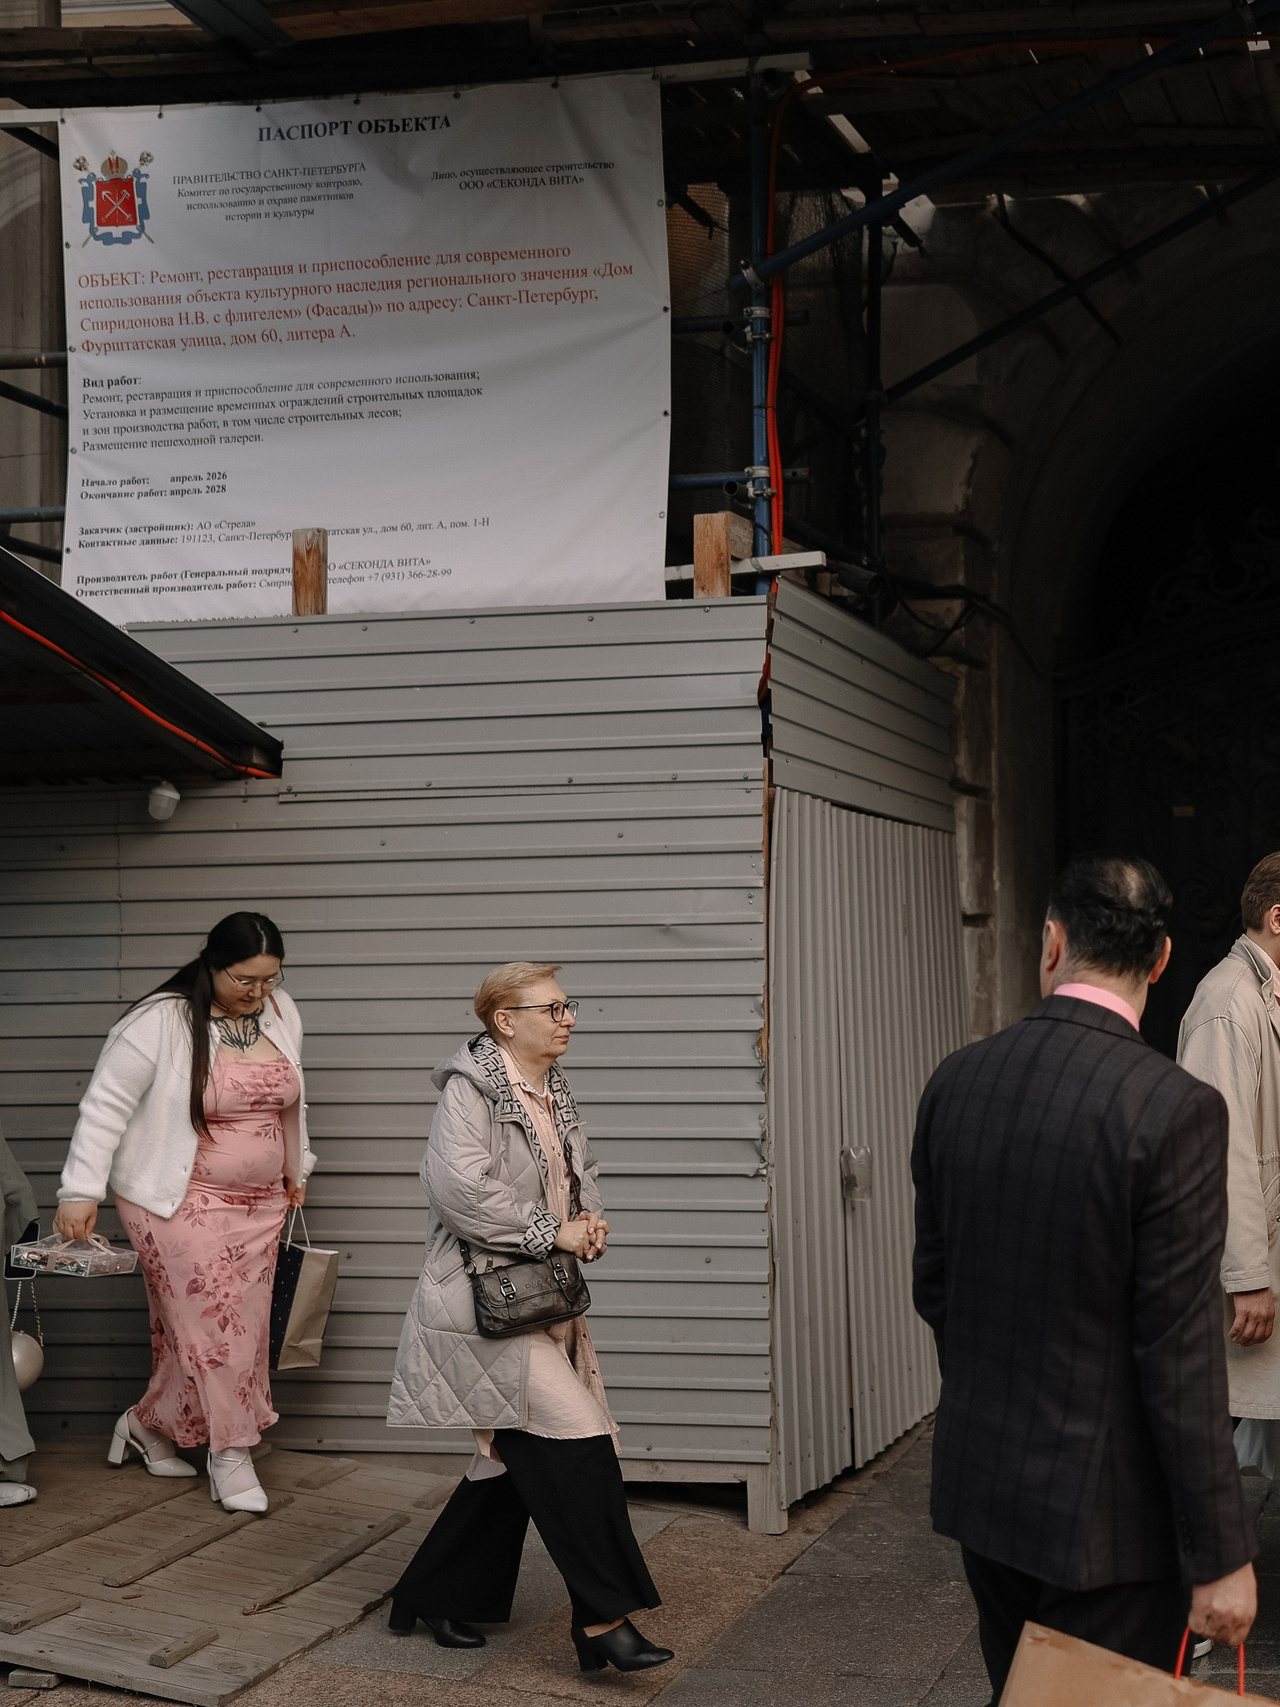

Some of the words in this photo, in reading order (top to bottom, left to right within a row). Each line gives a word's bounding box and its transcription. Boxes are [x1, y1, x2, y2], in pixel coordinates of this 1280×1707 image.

[258, 120, 351, 142] ПАСПОРТ
[358, 115, 450, 135] ОБЪЕКТА
[173, 170, 261, 185] ПРАВИТЕЛЬСТВО
[264, 162, 366, 180] САНКТ-ПЕТЕРБУРГА
[432, 171, 458, 180] Лицо,
[460, 166, 543, 177] осуществляющее
[546, 161, 614, 172] строительство
[459, 180, 483, 190] ООО
[487, 177, 546, 189] «СЕКОНДА
[549, 176, 584, 186] ВИТА»
[178, 189, 215, 198] Комитет
[219, 188, 230, 196] по
[232, 181, 313, 196] государственному
[316, 178, 362, 189] контролю,
[187, 200, 256, 211] использованию
[267, 196, 297, 207] охране
[300, 192, 354, 203] памятников
[226, 211, 261, 221] истории
[273, 208, 314, 220] культуры
[78, 271, 145, 289] ОБЪЕКТ:
[151, 270, 203, 284] Ремонт,
[208, 264, 294, 283] реставрация
[298, 264, 307, 274] и
[312, 253, 431, 274] приспособление
[436, 252, 461, 266] для
[466, 247, 571, 264] современного
[79, 295, 181, 311] использования
[187, 289, 240, 303] объекта
[245, 283, 332, 300] культурного
[336, 278, 402, 294] наследия
[407, 272, 516, 292] регионального
[521, 266, 587, 282] значения
[593, 262, 633, 279] «Дом
[80, 317, 174, 333] Спиридонова
[178, 312, 209, 326] Н.В.
[214, 314, 221, 323] с
[225, 308, 301, 327] флигелем»
[306, 301, 382, 320] (Фасады)»
[387, 303, 404, 312] по
[409, 297, 463, 314] адресу:
[467, 287, 598, 307] Санкт-Петербург,
[82, 338, 176, 355] Фурштатская
[181, 335, 226, 351] улица,
[230, 333, 256, 345] дом
[261, 328, 282, 344] 60,
[286, 328, 335, 342] литера
[340, 325, 355, 338] А.
[83, 378, 104, 388] Вид
[107, 376, 141, 389] работ:
[83, 394, 123, 403] Ремонт,
[126, 390, 192, 403] реставрация
[205, 383, 292, 399] приспособление
[295, 382, 314, 392] для
[317, 377, 392, 391] современного
[396, 371, 480, 384] использования;
[83, 409, 137, 420] Установка
[150, 405, 214, 418] размещение
[217, 401, 275, 414] временных
[279, 394, 344, 410] ограждений
[347, 391, 423, 406] строительных
[427, 388, 482, 399] площадок
[83, 427, 89, 435] и
[93, 427, 110, 435] зон
[113, 422, 184, 436] производства
[188, 419, 219, 432] работ,
[232, 418, 250, 427] том
[254, 417, 284, 425] числе
[288, 412, 364, 425] строительных
[368, 409, 402, 419] лесов;
[83, 439, 148, 451] Размещение
[151, 435, 216, 448] пешеходной
[220, 434, 263, 445] галереи.
[81, 479, 117, 487] Начало
[120, 477, 150, 486] работ:
[171, 475, 203, 484] апрель
[207, 472, 227, 481] 2026
[81, 491, 134, 500] Окончание
[138, 489, 167, 500] работ:
[170, 488, 202, 497] апрель
[205, 485, 226, 494] 2028
[78, 538, 136, 549] Контактные
[140, 536, 178, 546] данные:
[182, 534, 215, 544] 191123,
[381, 524, 398, 533] дом
[400, 523, 413, 532] 60,
[417, 522, 434, 531] лит.
[437, 521, 447, 530] А,
[450, 520, 470, 528] пом.
[79, 527, 122, 536] Заказчик
[125, 523, 193, 535] (застройщик):
[197, 522, 211, 530] АО
[215, 520, 256, 530] «Стрела»
[76, 585, 149, 597] Ответственный
[153, 583, 223, 594] производитель
[226, 581, 256, 591] работ:
[368, 572, 378, 581] +7
[382, 571, 404, 582] (931)
[407, 569, 452, 579] 366-28-99
[77, 574, 148, 584] Производитель
[151, 571, 177, 581] работ
[181, 567, 248, 580] (Генеральный
[338, 559, 394, 571] «СЕКОНДА
[398, 557, 431, 567] ВИТА»
